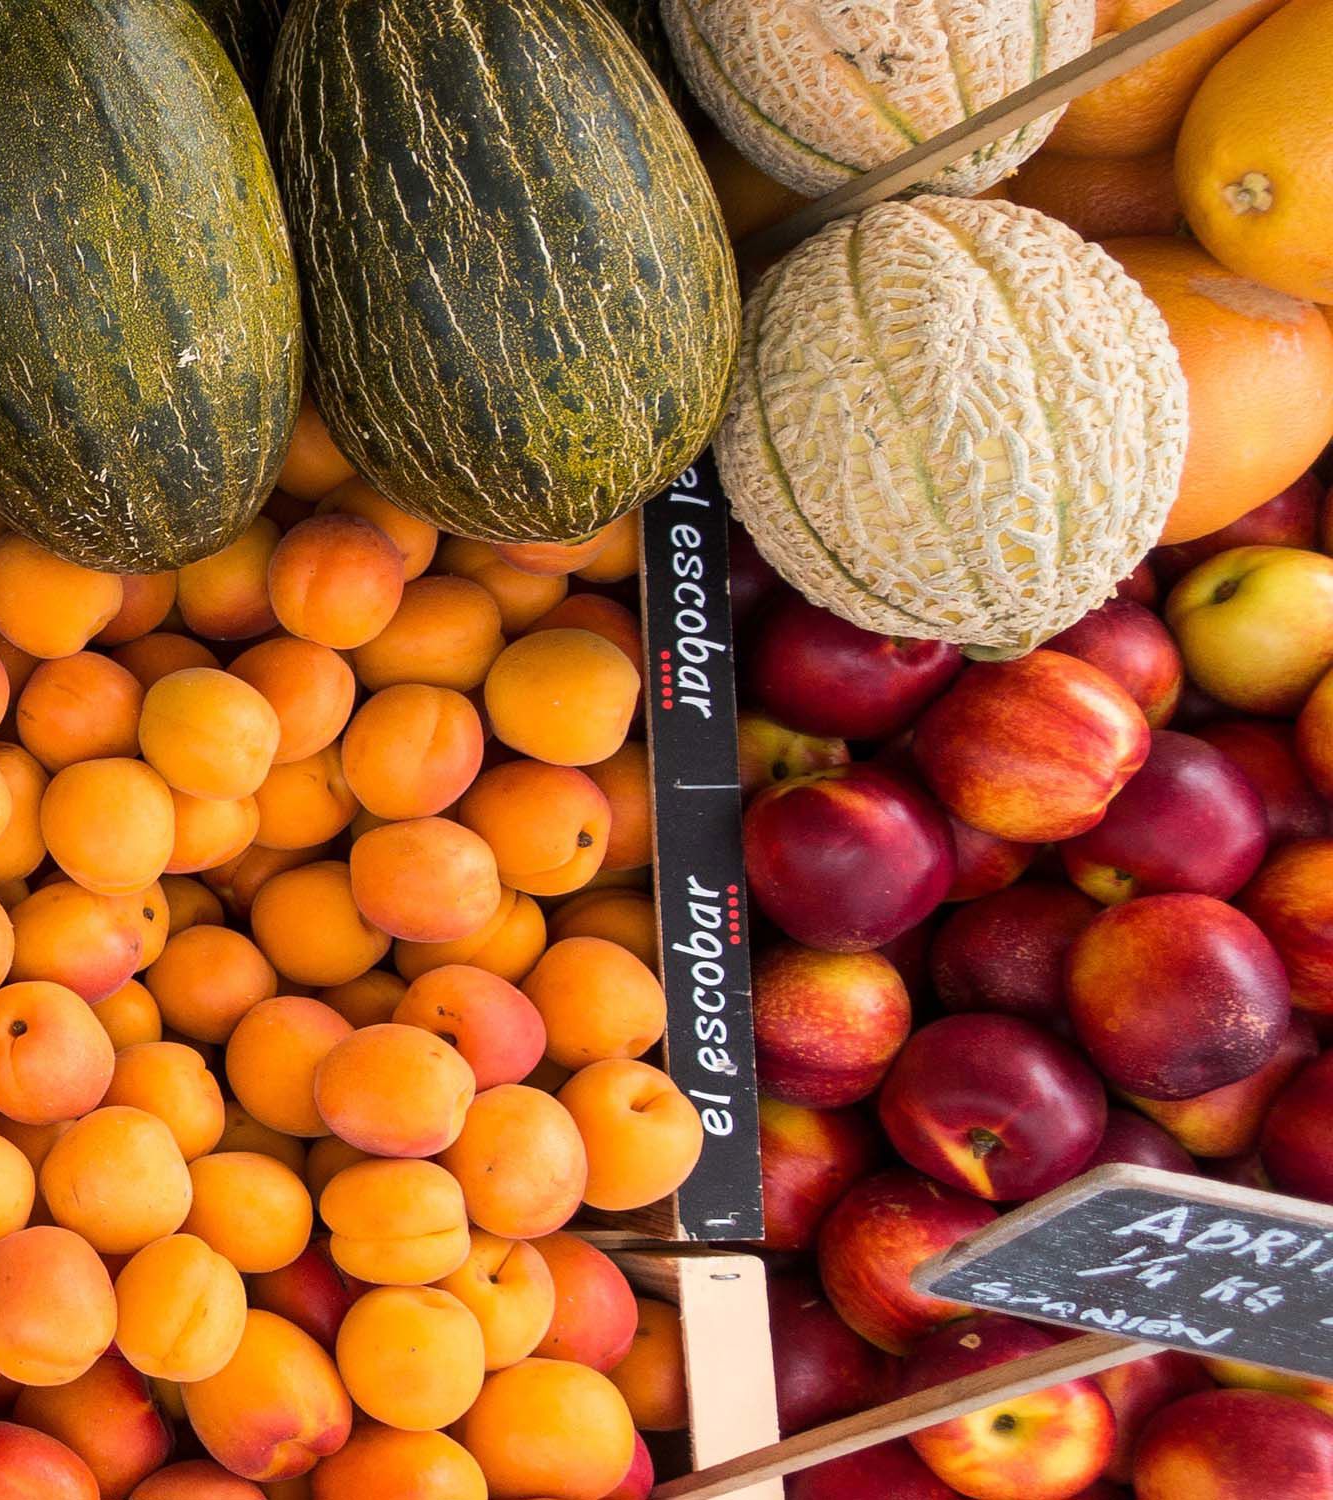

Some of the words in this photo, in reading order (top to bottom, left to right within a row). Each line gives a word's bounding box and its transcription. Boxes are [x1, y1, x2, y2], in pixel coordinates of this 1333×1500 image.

[670, 524, 726, 720] escobar
[671, 874, 733, 1074] escobar
[689, 1089, 733, 1136] el
